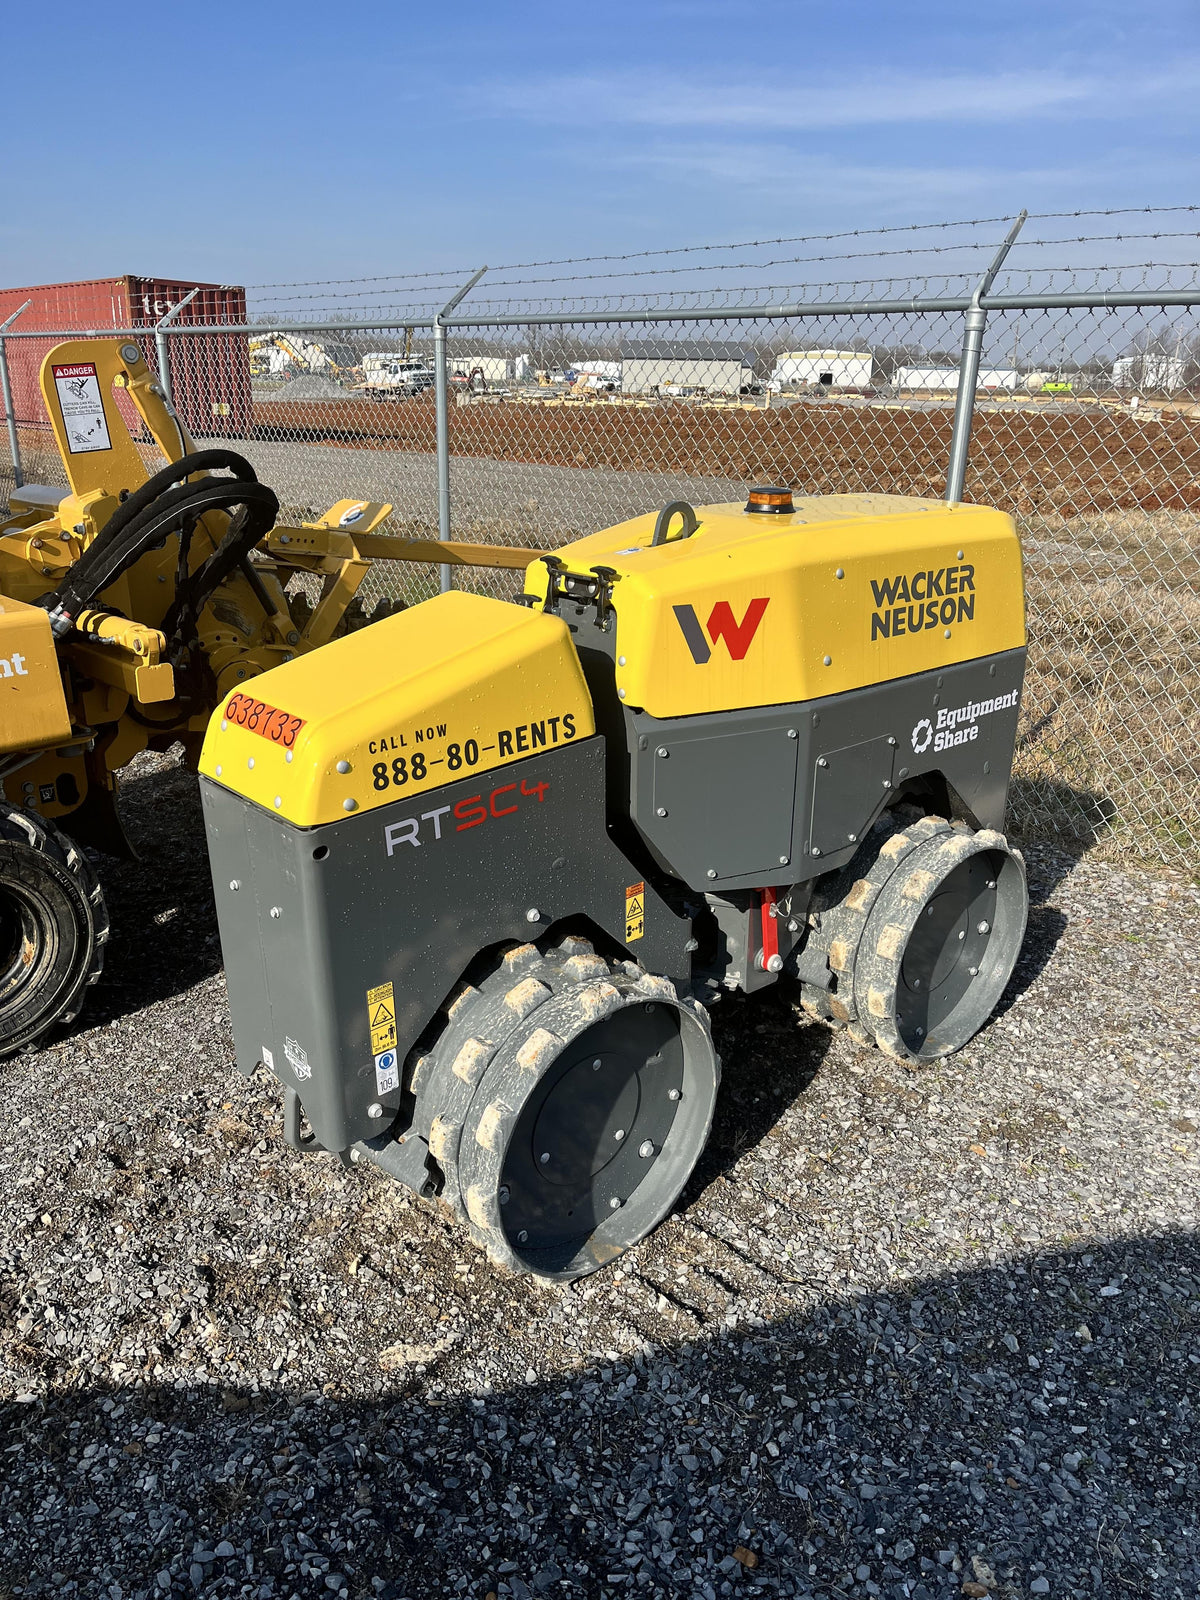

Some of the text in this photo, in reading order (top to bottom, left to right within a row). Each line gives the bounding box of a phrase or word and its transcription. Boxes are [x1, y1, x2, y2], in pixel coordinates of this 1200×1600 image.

[63, 367, 94, 376] DANGER
[870, 564, 975, 608] WACKER
[871, 594, 975, 641] NEUSON
[226, 694, 302, 746] 638133
[936, 689, 1018, 730] Equipment
[368, 724, 447, 754] CALL NOW
[372, 714, 576, 791] 888-80-RENTS
[934, 725, 979, 753] Share
[380, 1077, 393, 1092] 109
